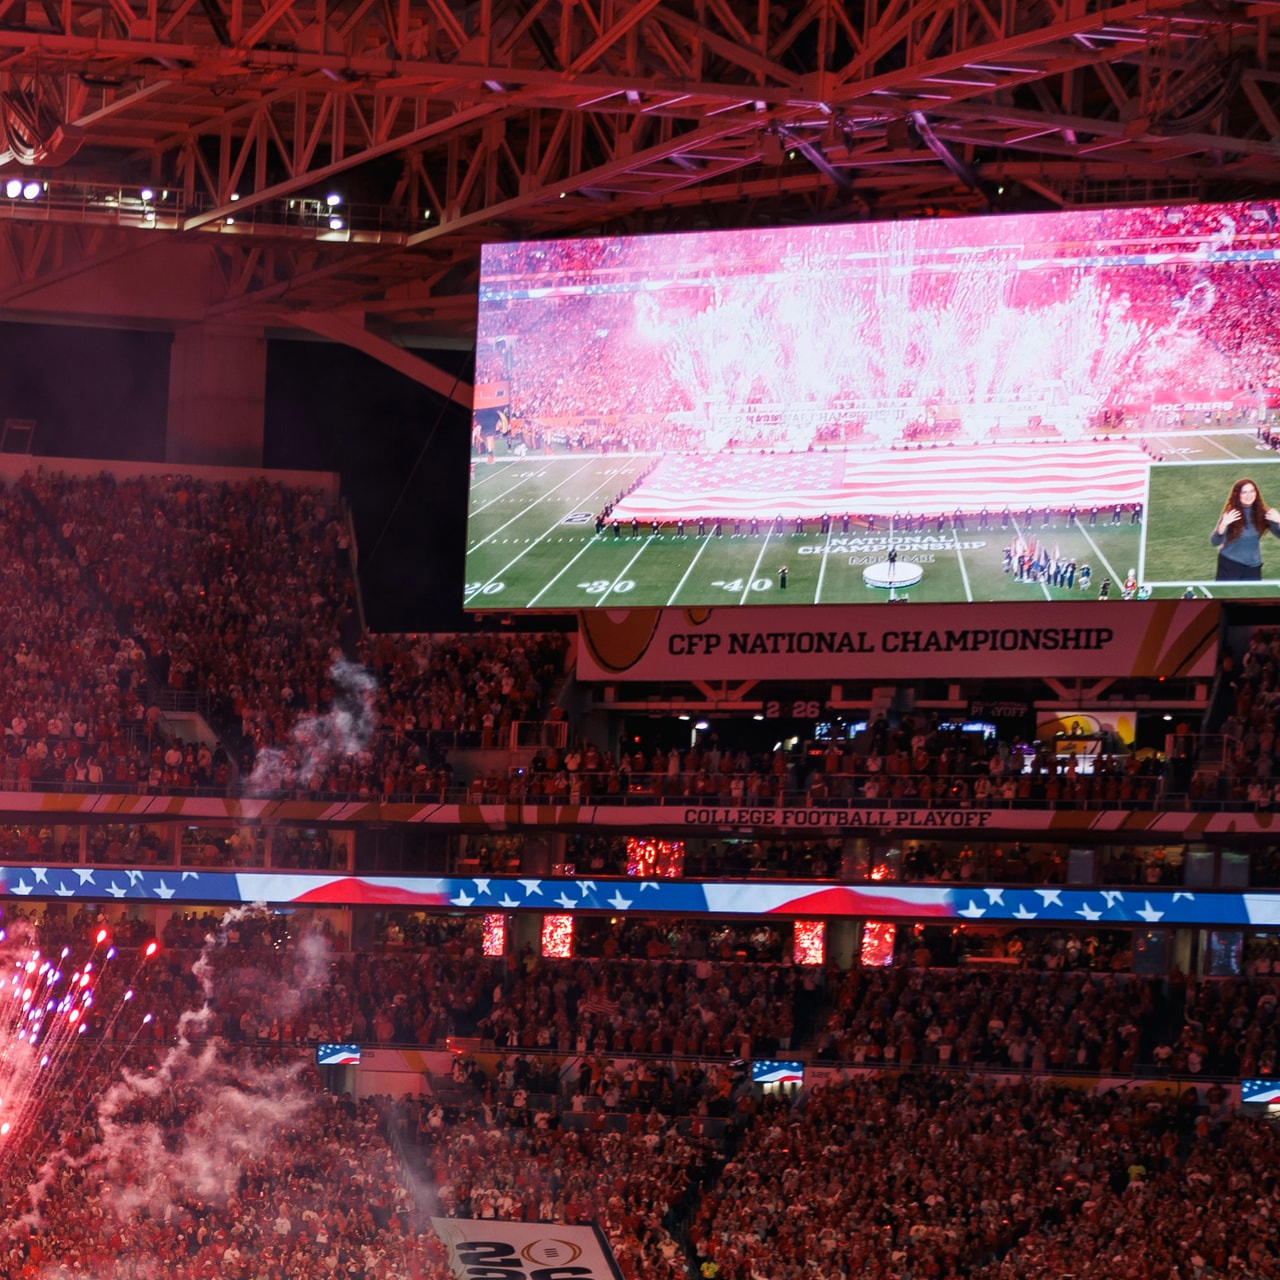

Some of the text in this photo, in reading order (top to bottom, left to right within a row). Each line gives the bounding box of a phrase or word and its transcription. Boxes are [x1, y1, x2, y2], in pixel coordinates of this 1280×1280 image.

[797, 541, 987, 555] CHAMPIONSHIP
[830, 534, 956, 547] NATIONAL
[668, 627, 1114, 656] CFP NATIONAL CHAMPIONSHIP
[684, 809, 993, 827] COLLEGE FOOTBALL PLAYOFF
